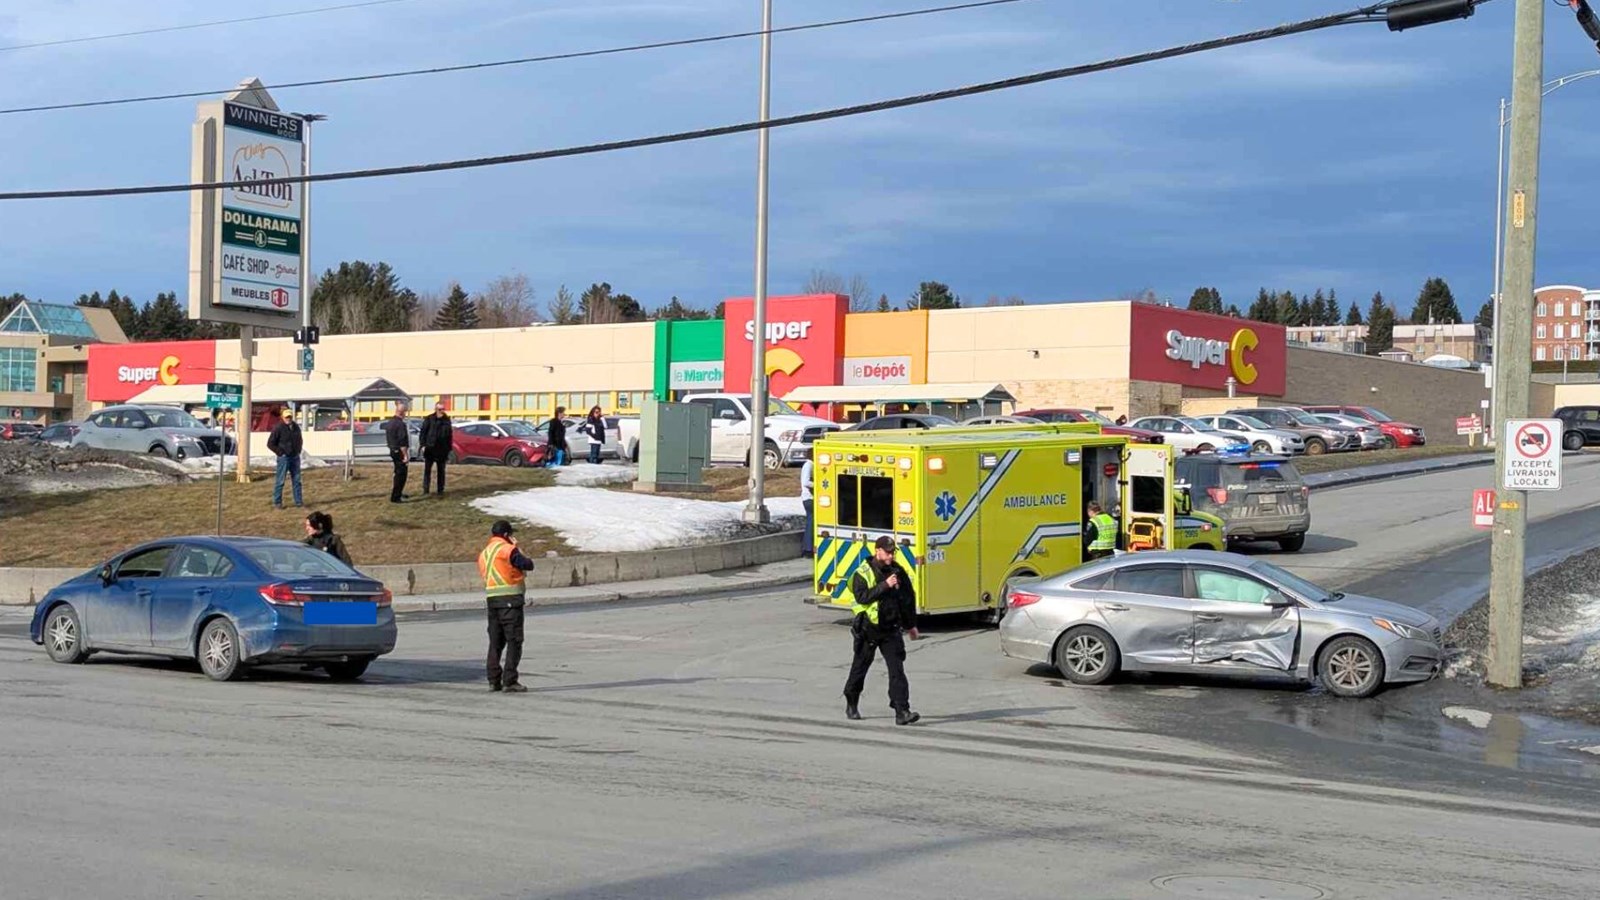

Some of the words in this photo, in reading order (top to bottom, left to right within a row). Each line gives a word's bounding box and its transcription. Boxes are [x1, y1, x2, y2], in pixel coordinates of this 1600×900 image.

[229, 105, 298, 132] WINNERS
[277, 129, 297, 139] MODE
[223, 210, 299, 235] DOLLARAMA
[223, 253, 245, 272] CAFÉ
[247, 257, 270, 275] SHOP
[231, 287, 270, 301] MEUBLES
[1165, 329, 1230, 369] Super
[1230, 327, 1260, 386] C
[118, 365, 160, 385] Super
[160, 355, 181, 386] C
[684, 367, 723, 383] March
[852, 364, 863, 378] le
[863, 361, 905, 380] Dépôt
[1511, 459, 1553, 468] EXCEPTÉ
[1507, 469, 1557, 477] LIVRAISON
[1513, 477, 1549, 486] LOCALE
[1003, 493, 1067, 509] AMBULANCE
